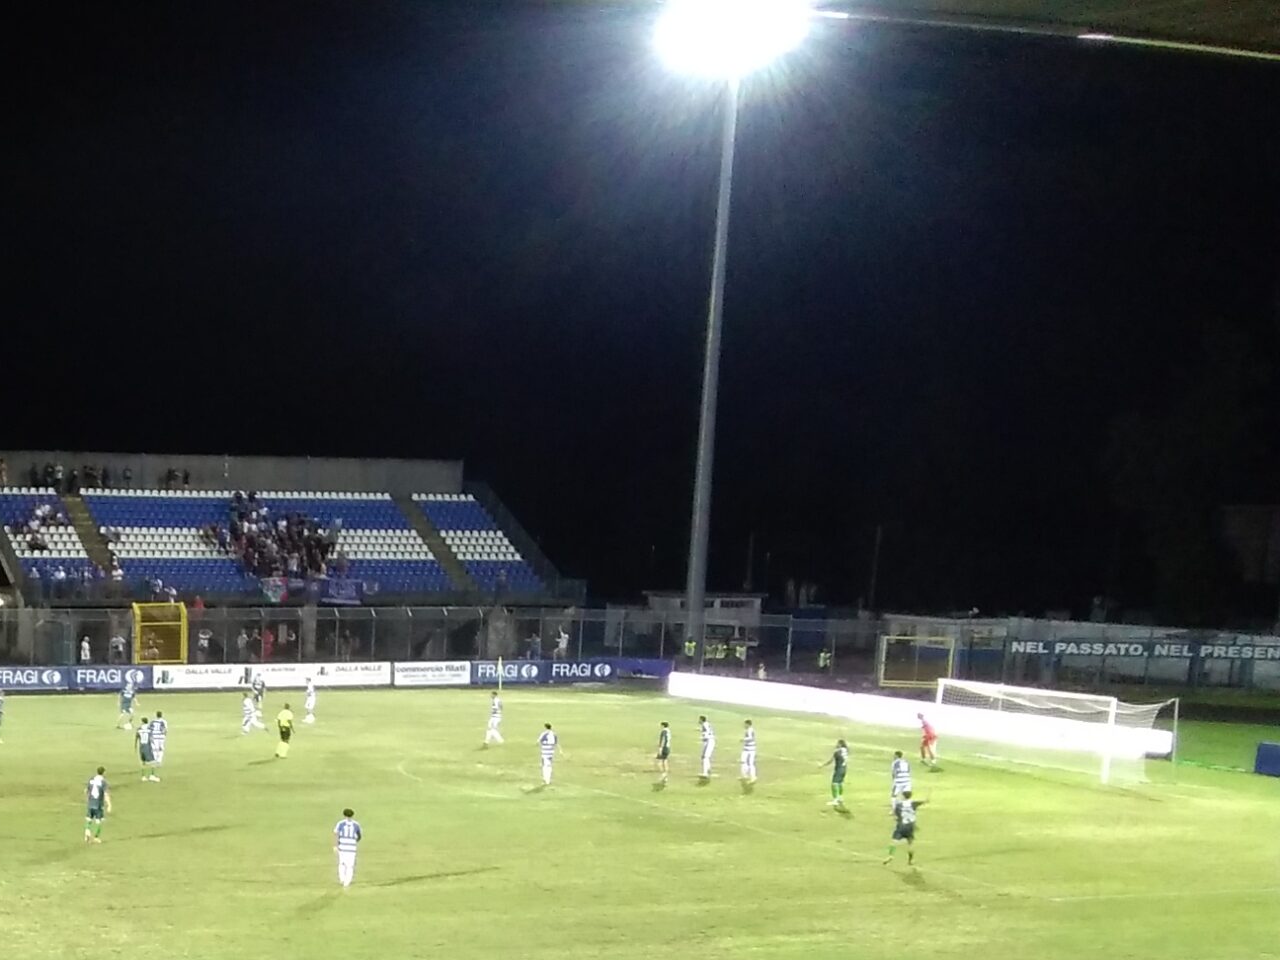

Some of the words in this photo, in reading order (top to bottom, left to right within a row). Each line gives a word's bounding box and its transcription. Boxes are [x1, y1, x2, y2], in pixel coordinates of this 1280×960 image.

[1011, 641, 1049, 654] NEL
[1054, 642, 1149, 657] PASSATO,
[1154, 644, 1194, 657] NEL
[77, 669, 121, 684] FRAGI
[477, 664, 519, 679] FRAGI
[552, 663, 592, 677] FRAGI
